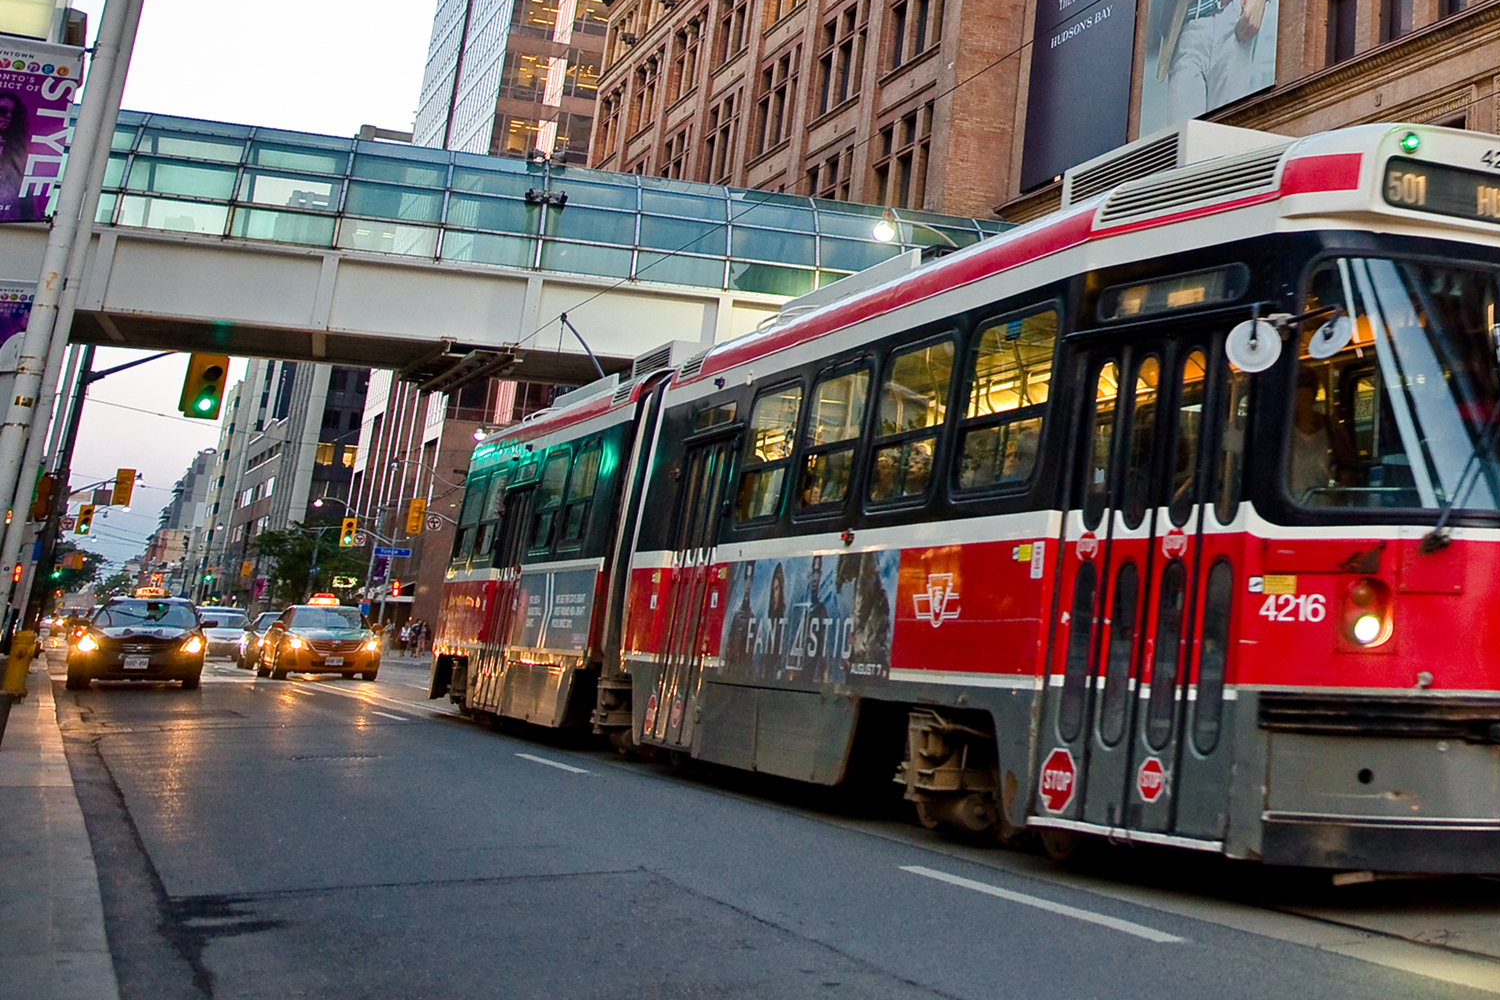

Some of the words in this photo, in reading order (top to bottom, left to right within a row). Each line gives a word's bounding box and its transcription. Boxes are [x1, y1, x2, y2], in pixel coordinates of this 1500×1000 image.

[1050, 16, 1093, 49] HUDSON'S
[1094, 4, 1113, 24] BAY
[0, 73, 35, 84] NTO'S
[18, 76, 79, 198] STYLE
[1387, 170, 1427, 206] 501
[1259, 594, 1326, 622] 4216
[850, 663, 876, 675] AUGUST
[876, 664, 882, 676] 7
[1044, 769, 1072, 791] STOP
[1141, 770, 1162, 788] STOP
